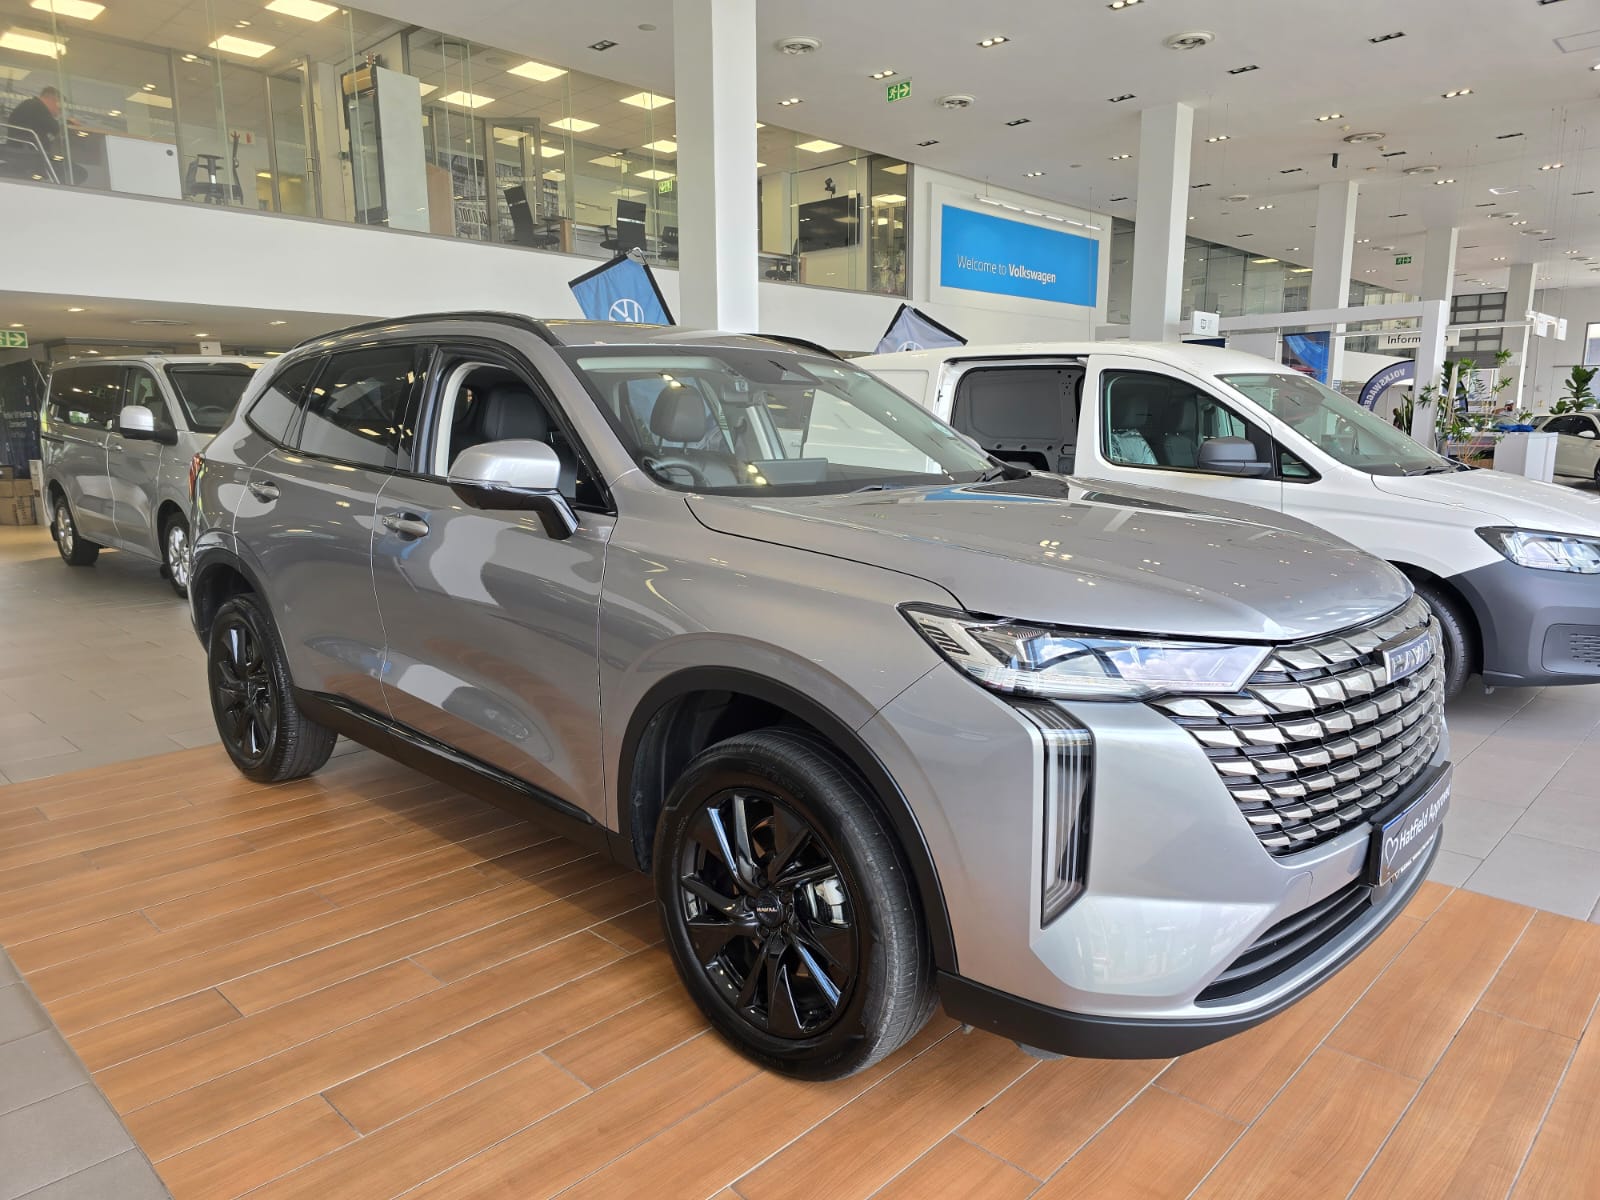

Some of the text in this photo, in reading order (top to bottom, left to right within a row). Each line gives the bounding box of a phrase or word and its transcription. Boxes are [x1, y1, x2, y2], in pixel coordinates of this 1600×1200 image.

[957, 254, 1056, 285] Welcome to Volkswagen
[1399, 807, 1429, 850] Hatfield
